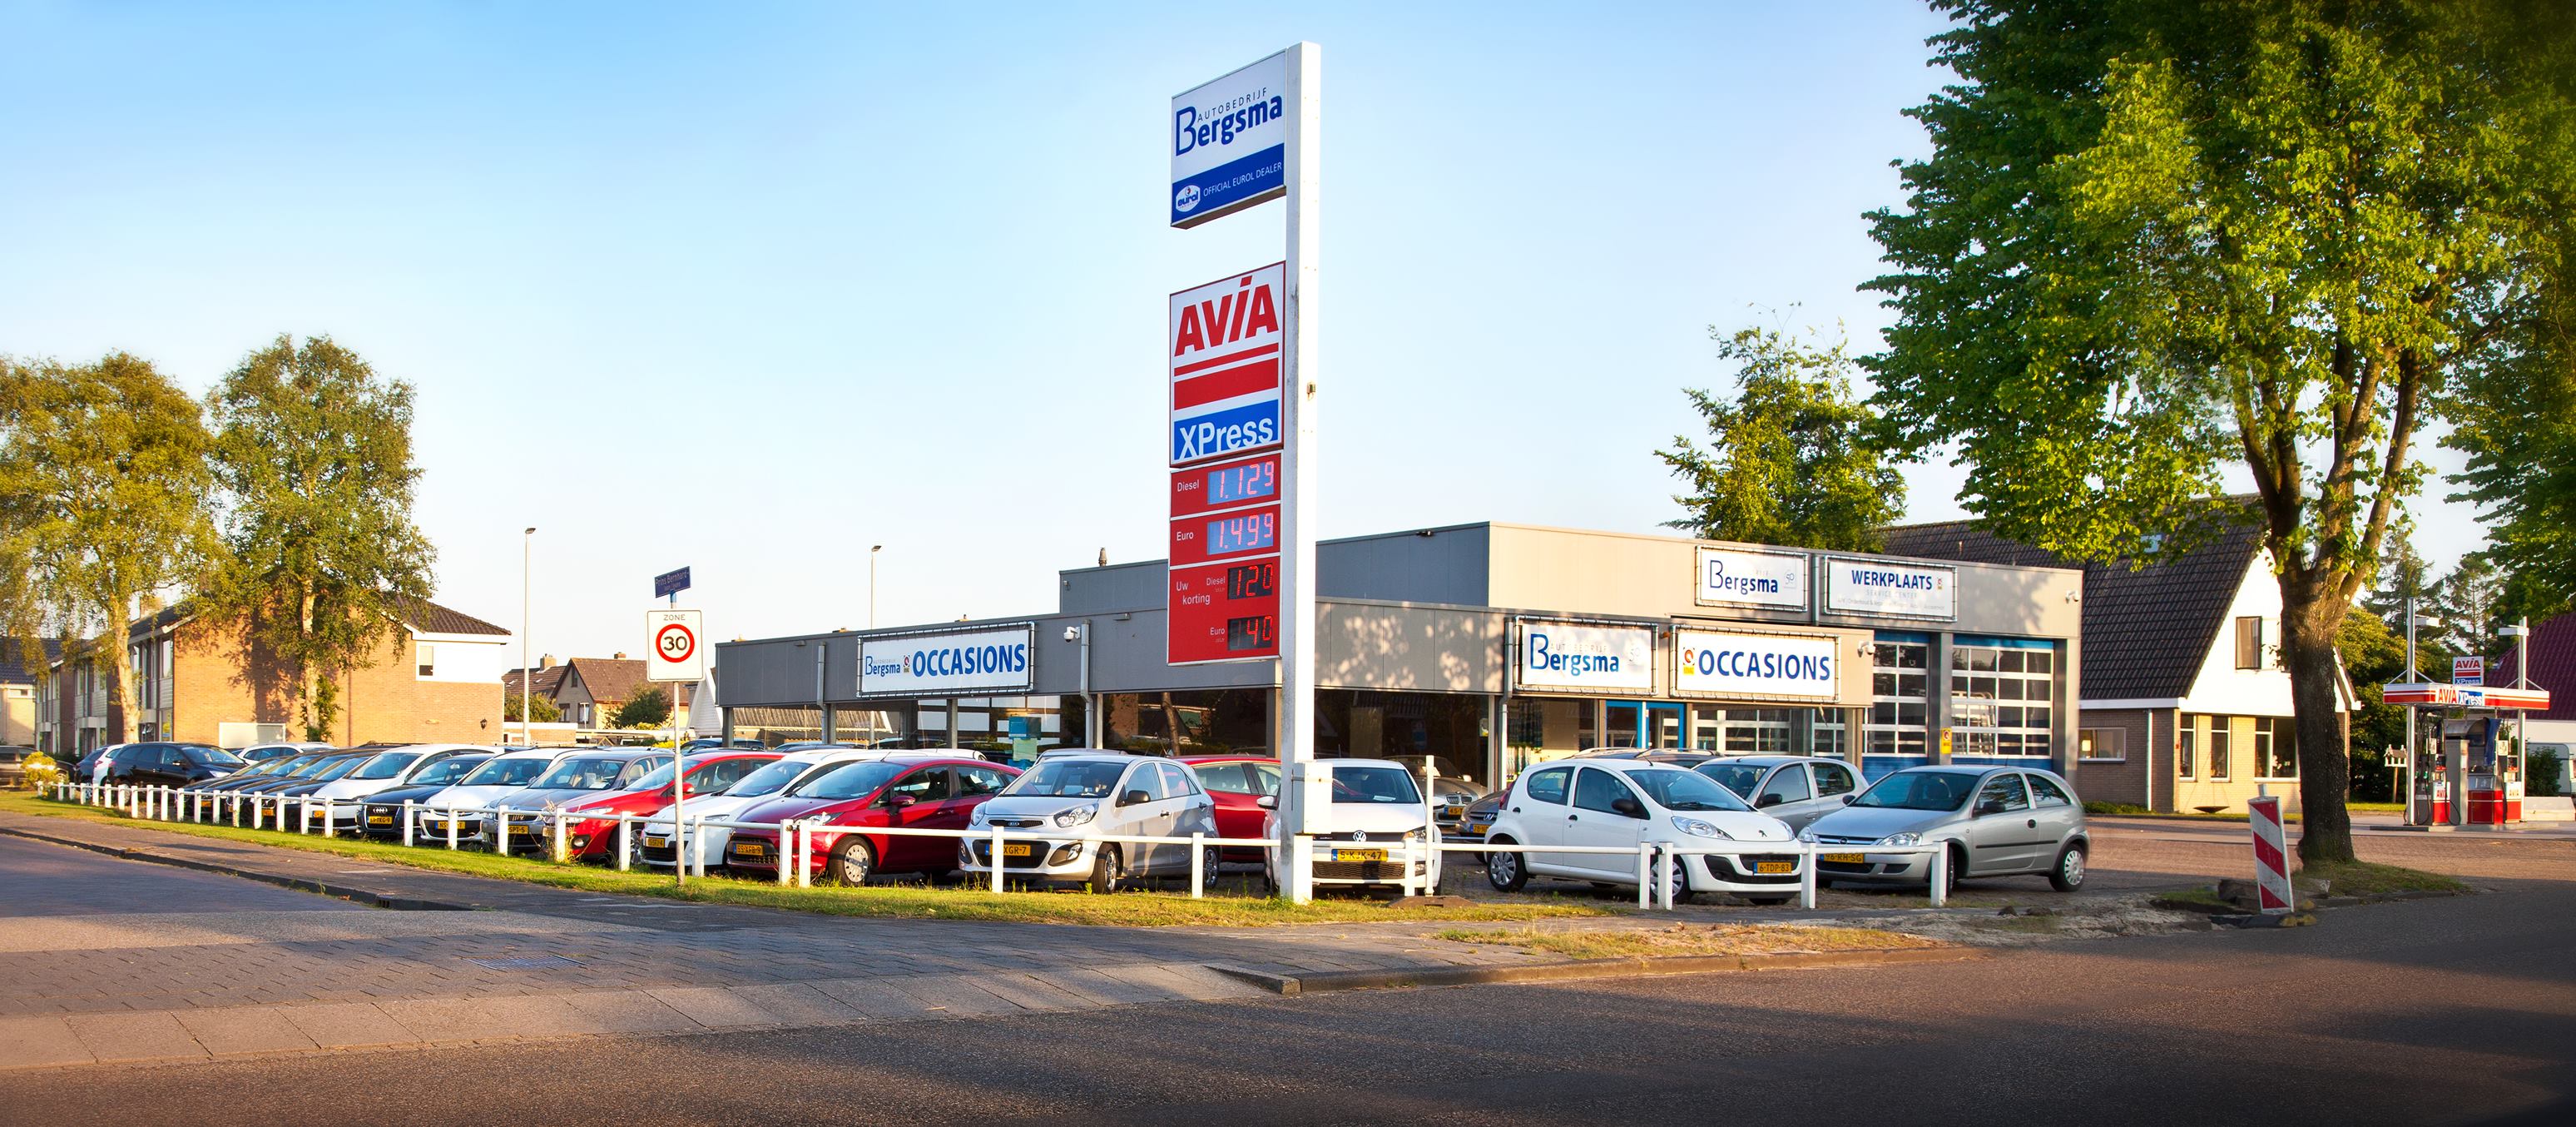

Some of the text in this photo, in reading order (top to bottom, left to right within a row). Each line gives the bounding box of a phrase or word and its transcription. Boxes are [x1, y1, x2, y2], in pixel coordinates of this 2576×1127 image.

[1197, 87, 1267, 122] AUTOBEDRIJF
[1176, 95, 1282, 156] Bergsma
[1203, 161, 1282, 197] OFFICIAL EUROL DEALER
[1177, 417, 1273, 460] XPress
[1177, 460, 1275, 499] Diesel 1.129
[1177, 512, 1274, 549] Euro 1.499
[1176, 581, 1189, 592] Uw
[1206, 576, 1226, 586] Diesel
[1710, 559, 1779, 595] Bergsma
[1851, 569, 1933, 590] WERKPLAATS
[1182, 594, 1211, 605] korting
[663, 636, 687, 651] 30
[1210, 627, 1226, 636] Euro
[865, 655, 901, 677] Bergsma
[912, 643, 1026, 678] OCCASIONS
[1530, 633, 1619, 676] Bergsma
[1698, 649, 1830, 681] OCCASIONS
[2459, 692, 2483, 706] XPress
[1758, 863, 1790, 872] 6-TDP-83
